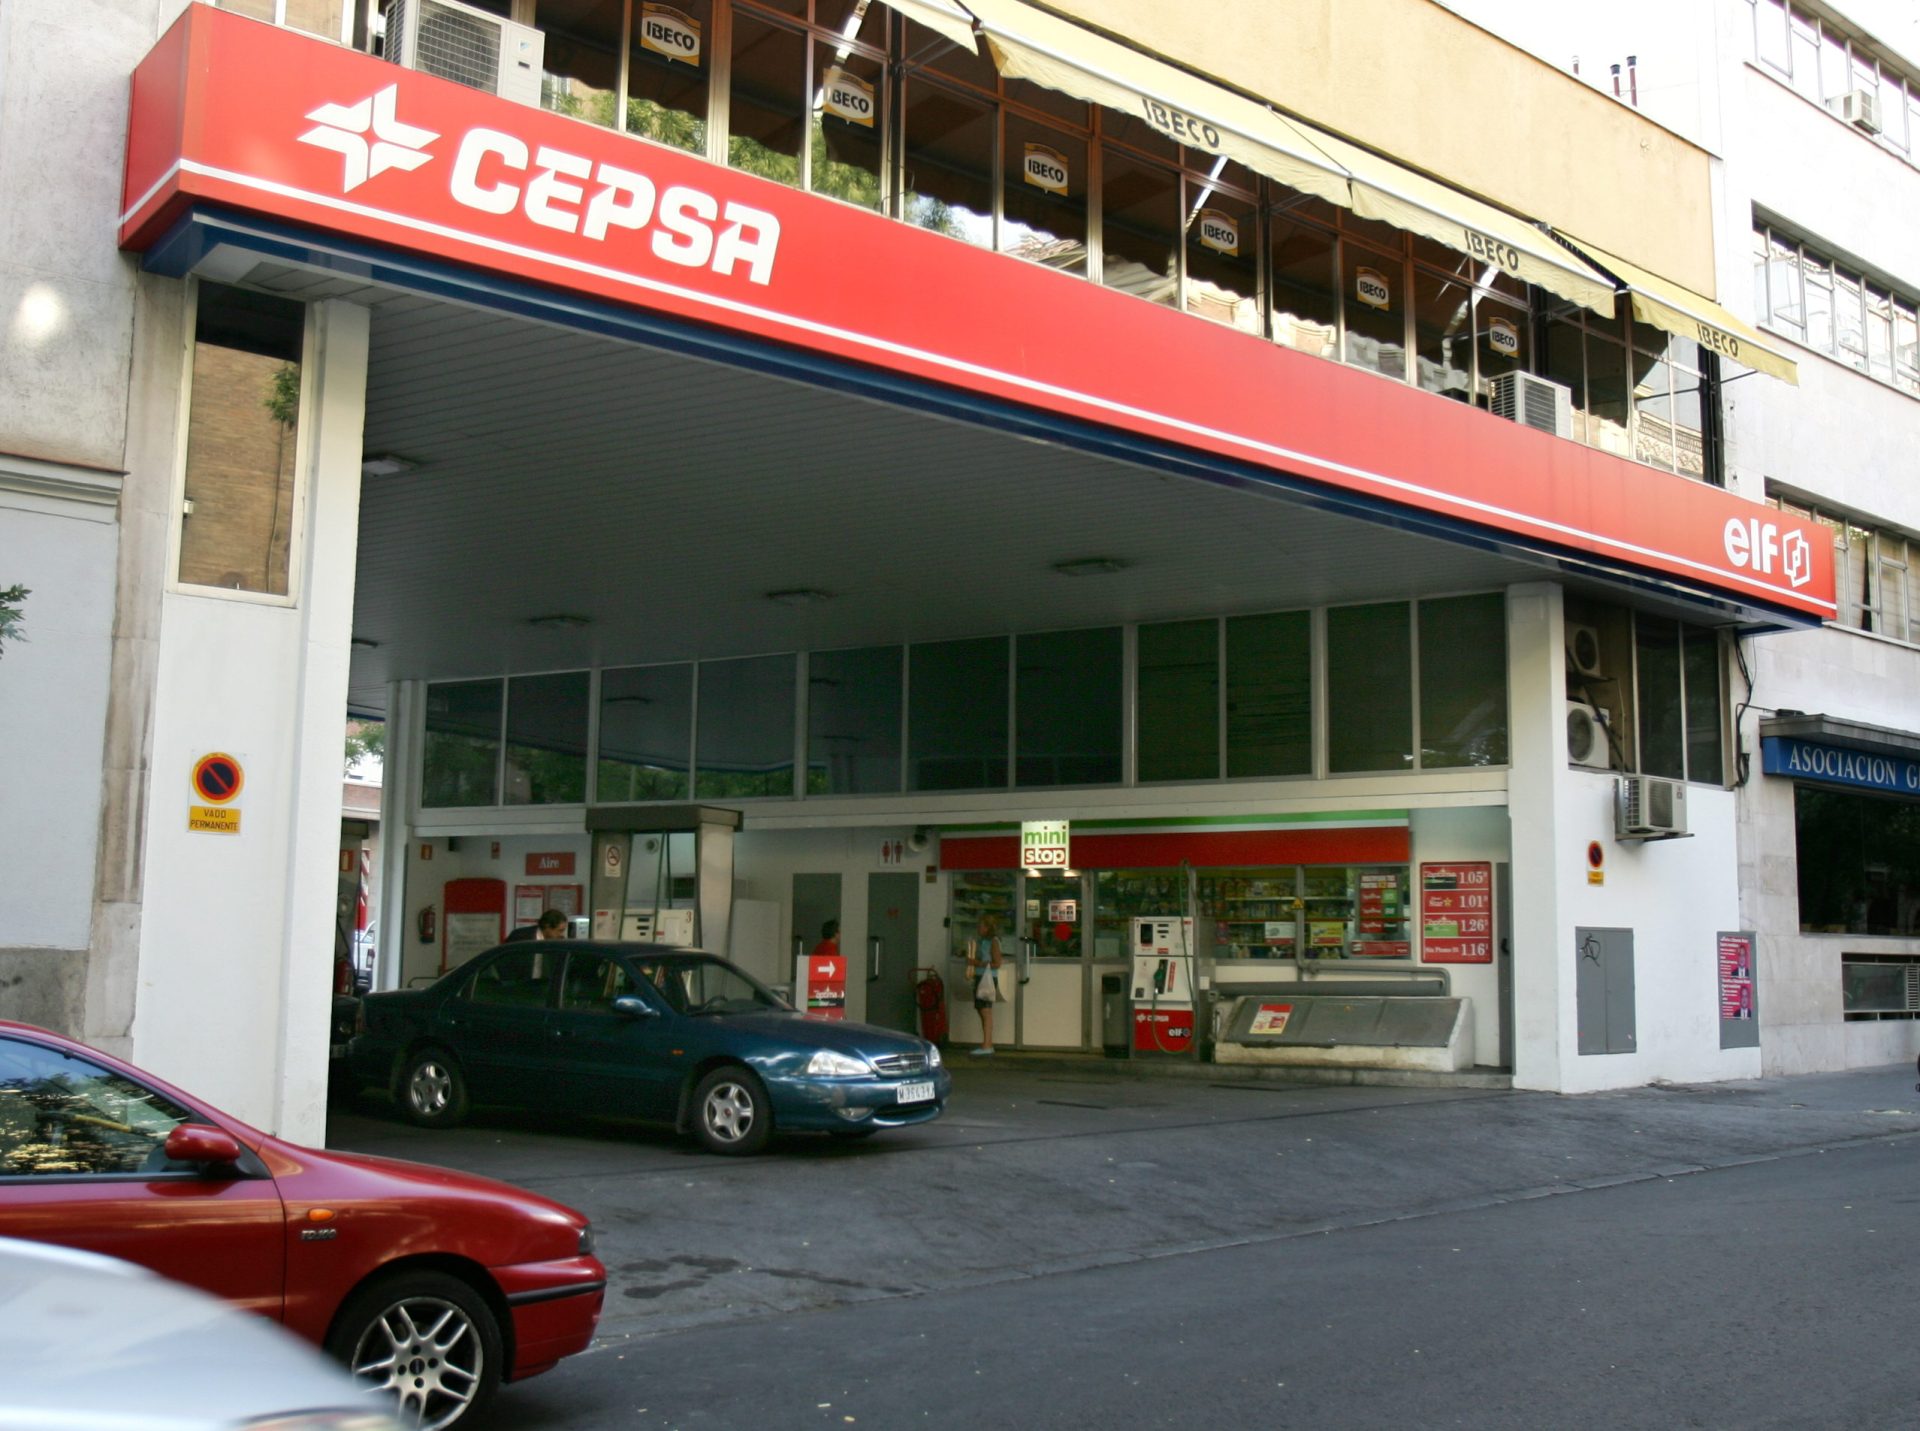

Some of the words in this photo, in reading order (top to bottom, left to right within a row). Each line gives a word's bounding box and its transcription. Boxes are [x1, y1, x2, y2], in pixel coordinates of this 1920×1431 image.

[647, 21, 695, 51] IBECO
[831, 87, 870, 113] BECO
[1142, 98, 1220, 148] IBECO
[1028, 158, 1064, 183] IBECO
[450, 128, 781, 286] CEPSA
[1204, 223, 1235, 245] IBECO
[1464, 229, 1519, 271] IBECO
[1359, 280, 1386, 300] IBECO
[1491, 330, 1515, 347] IBECO
[1696, 322, 1739, 358] IBECO
[1724, 518, 1778, 574] elf
[1788, 744, 1896, 786] ASOCIACION
[1905, 764, 1920, 792] G
[190, 819, 238, 831] PERMANENTE
[204, 809, 227, 819] VADO
[1024, 825, 1067, 845] mini
[539, 857, 560, 869] Aire
[1025, 848, 1066, 865] stop
